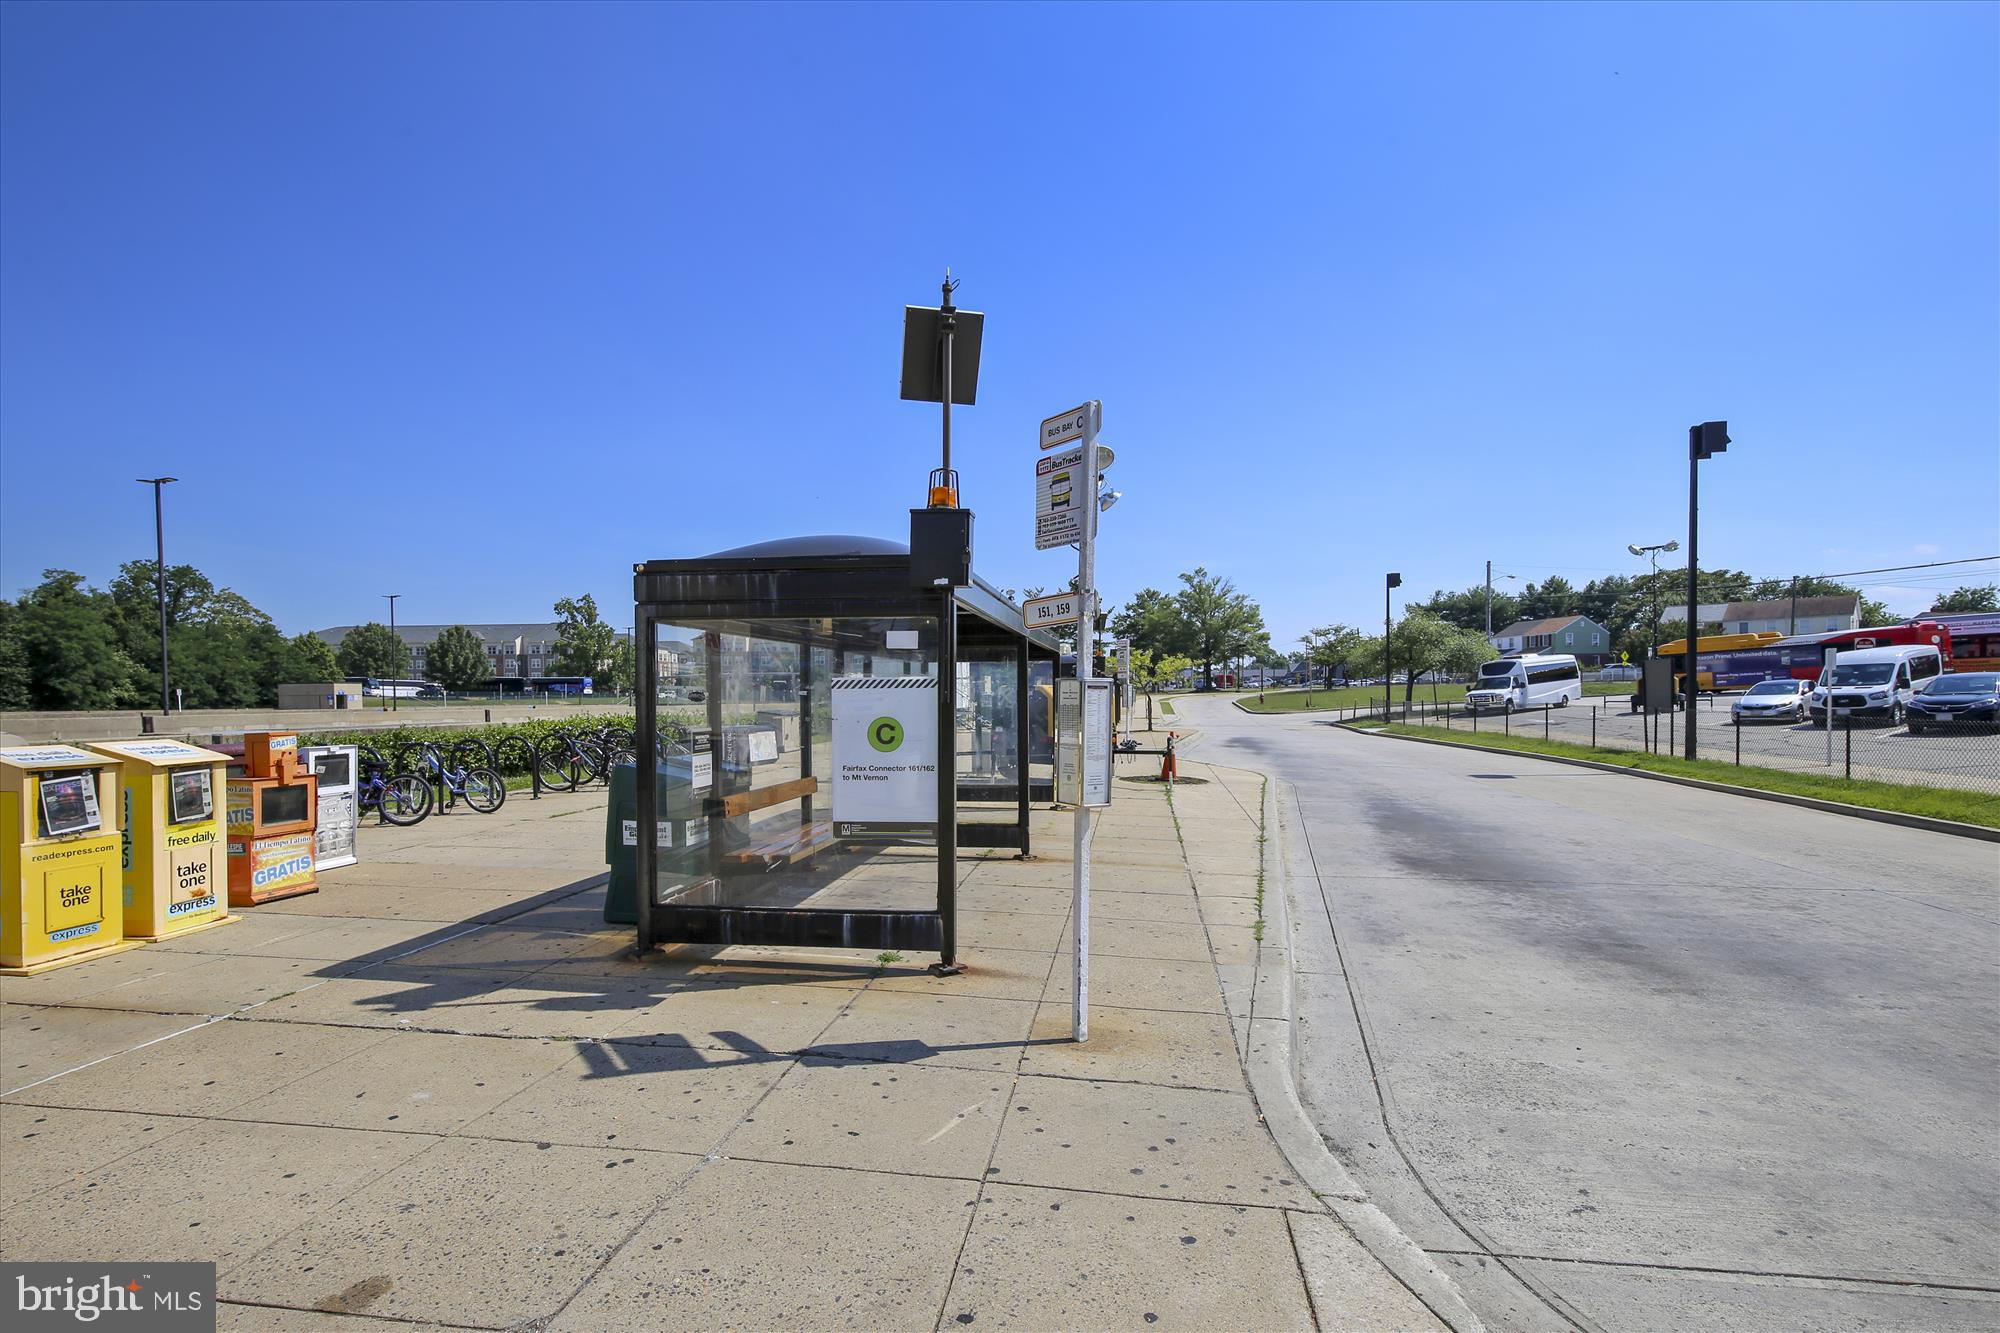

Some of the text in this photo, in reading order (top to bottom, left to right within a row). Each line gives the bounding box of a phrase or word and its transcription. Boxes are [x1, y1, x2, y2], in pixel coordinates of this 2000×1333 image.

[1048, 415, 1083, 437] BUS BAY C
[1038, 603, 1070, 619] 151, 159
[876, 723, 896, 745] C
[270, 737, 297, 749] GRATIS
[168, 831, 216, 847] free daily
[263, 839, 289, 849] Tiempo
[290, 836, 311, 845] Latino
[32, 844, 114, 862] readexpress.com
[176, 861, 207, 877] take
[254, 855, 311, 886] GRATIS
[180, 874, 206, 888] one
[60, 885, 92, 899] take
[62, 895, 90, 908] one
[169, 896, 216, 914] express
[52, 924, 98, 941] express
